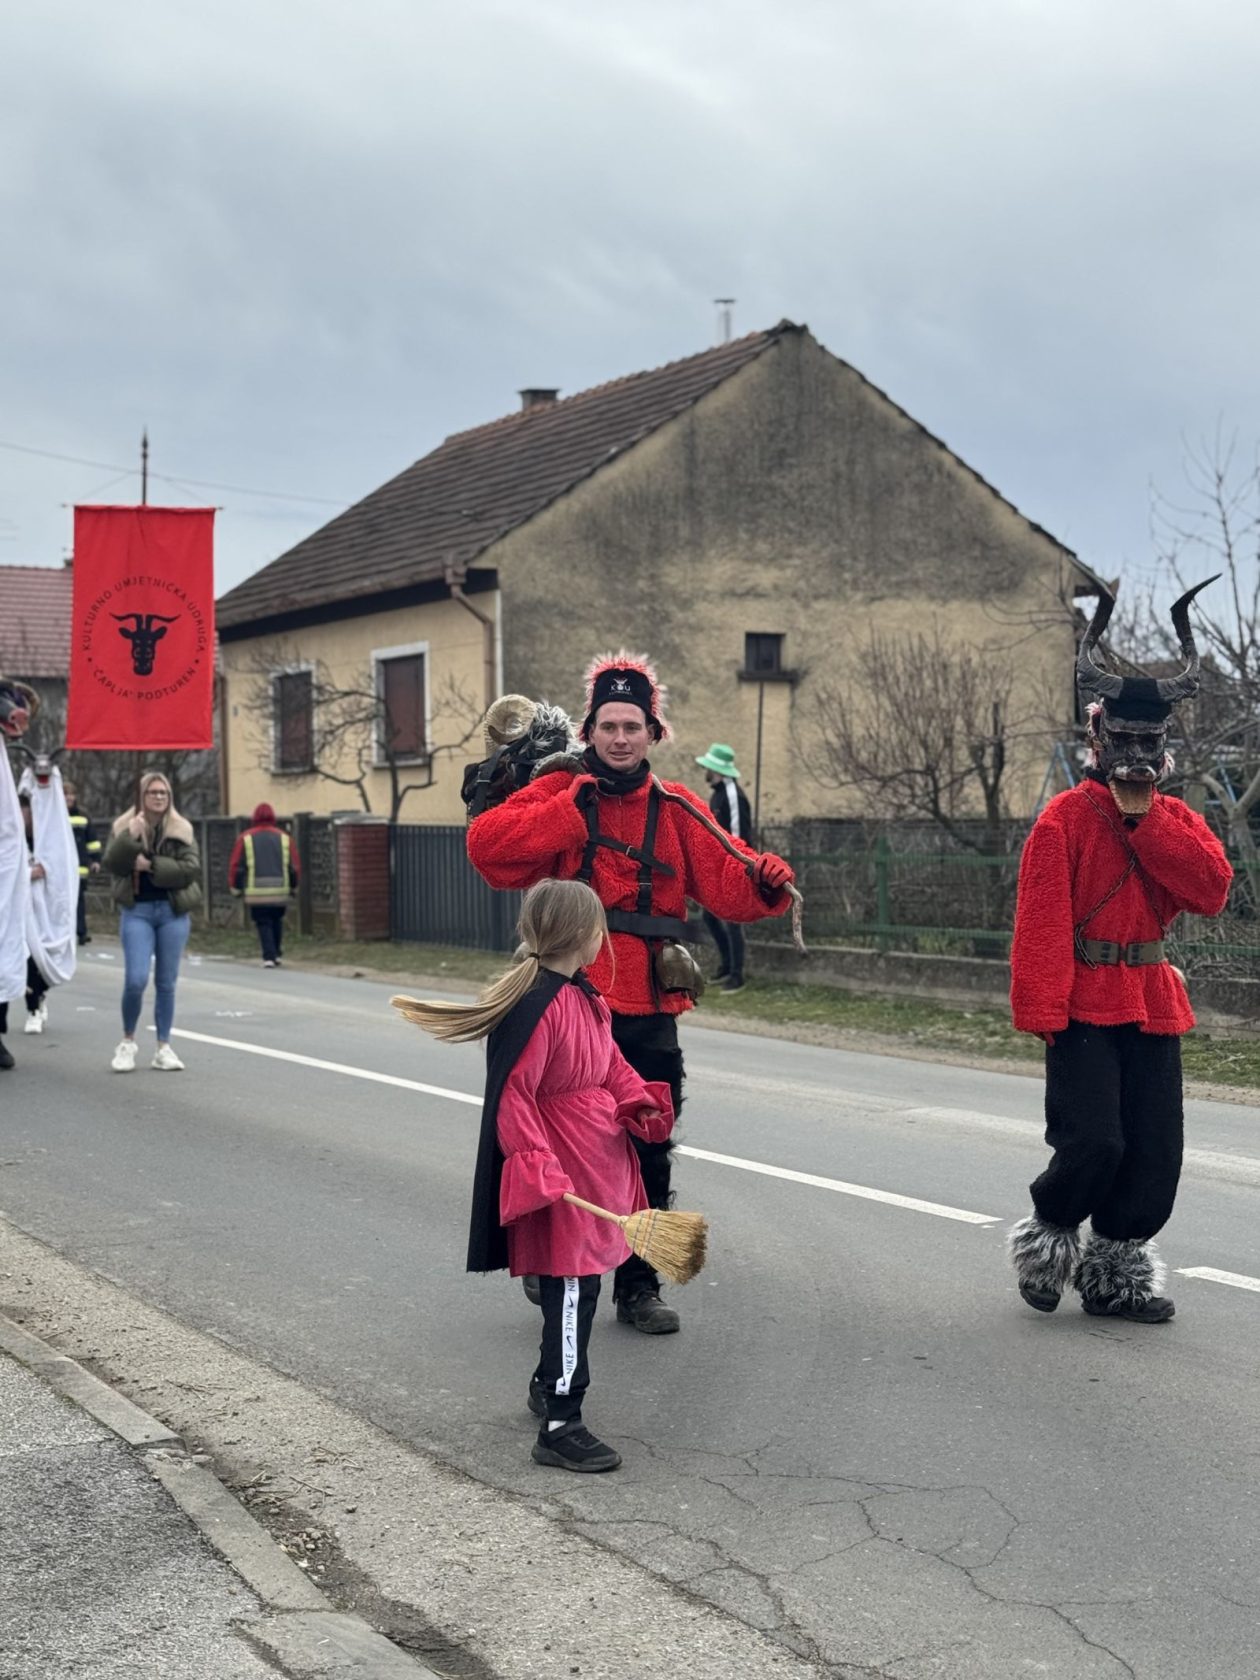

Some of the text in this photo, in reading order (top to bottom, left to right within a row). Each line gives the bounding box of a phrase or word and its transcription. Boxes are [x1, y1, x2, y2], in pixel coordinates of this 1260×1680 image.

[82, 590, 112, 651] KULTURNO
[187, 602, 207, 652] UDRUGA
[137, 667, 196, 700] PODTUREN
[565, 1310, 574, 1332] NIKE
[565, 1353, 574, 1374] NIKE
